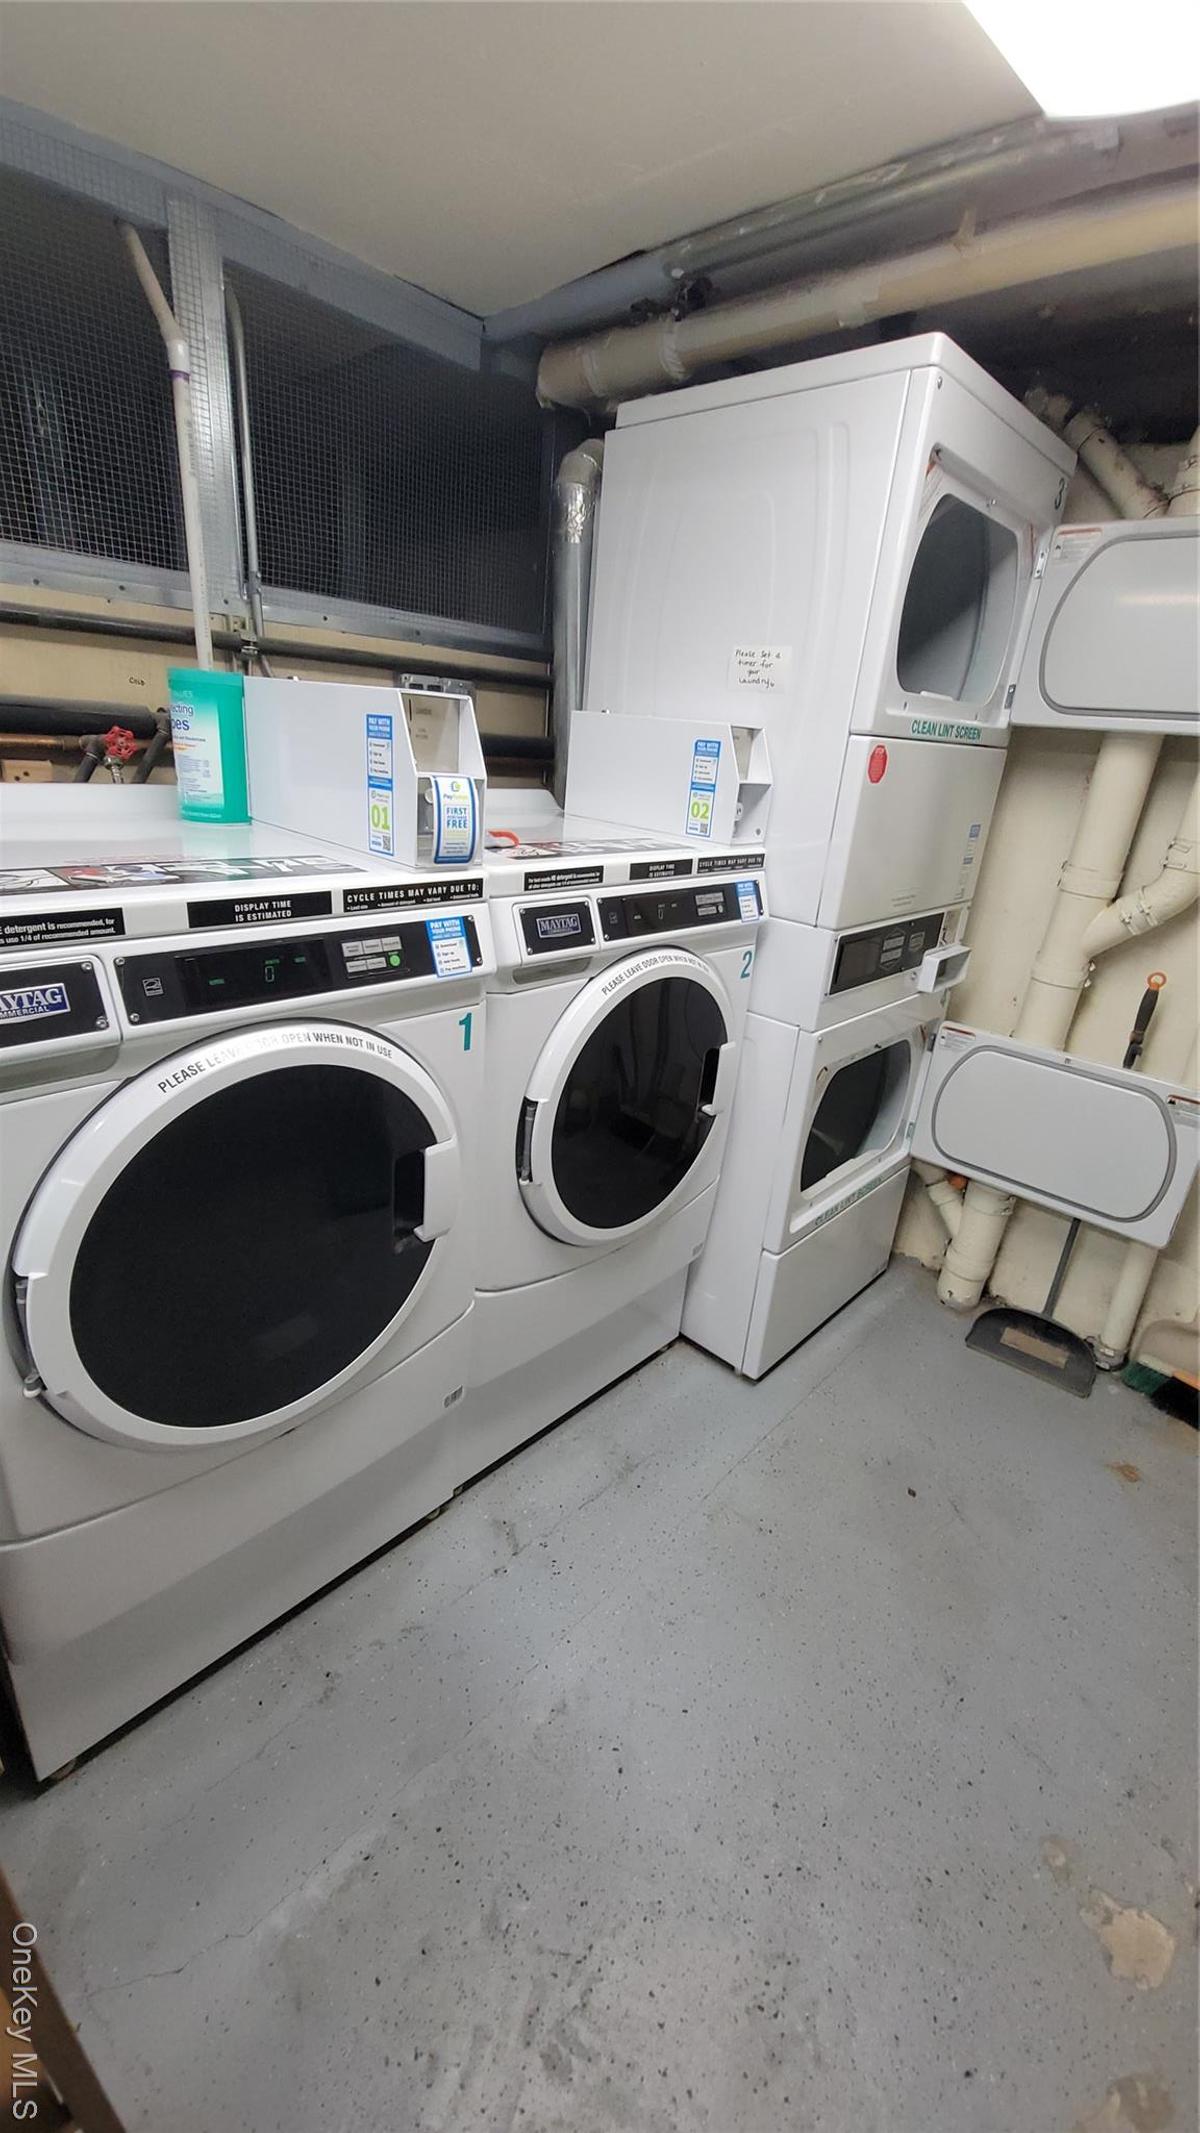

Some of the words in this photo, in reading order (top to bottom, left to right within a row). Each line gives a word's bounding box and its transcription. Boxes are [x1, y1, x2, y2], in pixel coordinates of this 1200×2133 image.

[1055, 478, 1065, 510] 3
[760, 659, 773, 668] for
[911, 720, 937, 736] CLEAN
[938, 723, 954, 737] LINT
[955, 725, 981, 740] SCREEN
[371, 804, 390, 831] 01
[446, 807, 467, 815] FIRST
[691, 802, 709, 819] 02
[447, 820, 468, 829] FREE
[347, 892, 375, 903] CYCLE
[379, 890, 405, 900] TIMES
[407, 888, 424, 897] MAY
[427, 886, 447, 895] VARY
[450, 884, 464, 893] DUE
[467, 883, 480, 891] TO:
[234, 902, 270, 912] DISPLAY
[272, 900, 292, 909] TIME
[235, 914, 244, 922] IS
[246, 910, 292, 920] ESTIMATED
[541, 917, 578, 931] MAYTAG
[4, 922, 47, 934] detergent
[47, 921, 56, 931] is
[741, 950, 753, 979] 2
[601, 975, 626, 995] PLEASE
[625, 964, 644, 978] LEAVE
[642, 957, 659, 969] DOOR
[459, 1012, 473, 1051] 1
[158, 1061, 206, 1093] PLEASE
[206, 1047, 242, 1068] LEAV
[281, 1033, 311, 1044] OPEN
[312, 1032, 344, 1044] WHEN
[345, 1035, 363, 1047] NOT
[366, 1041, 375, 1051] IN
[376, 1045, 393, 1059] USE
